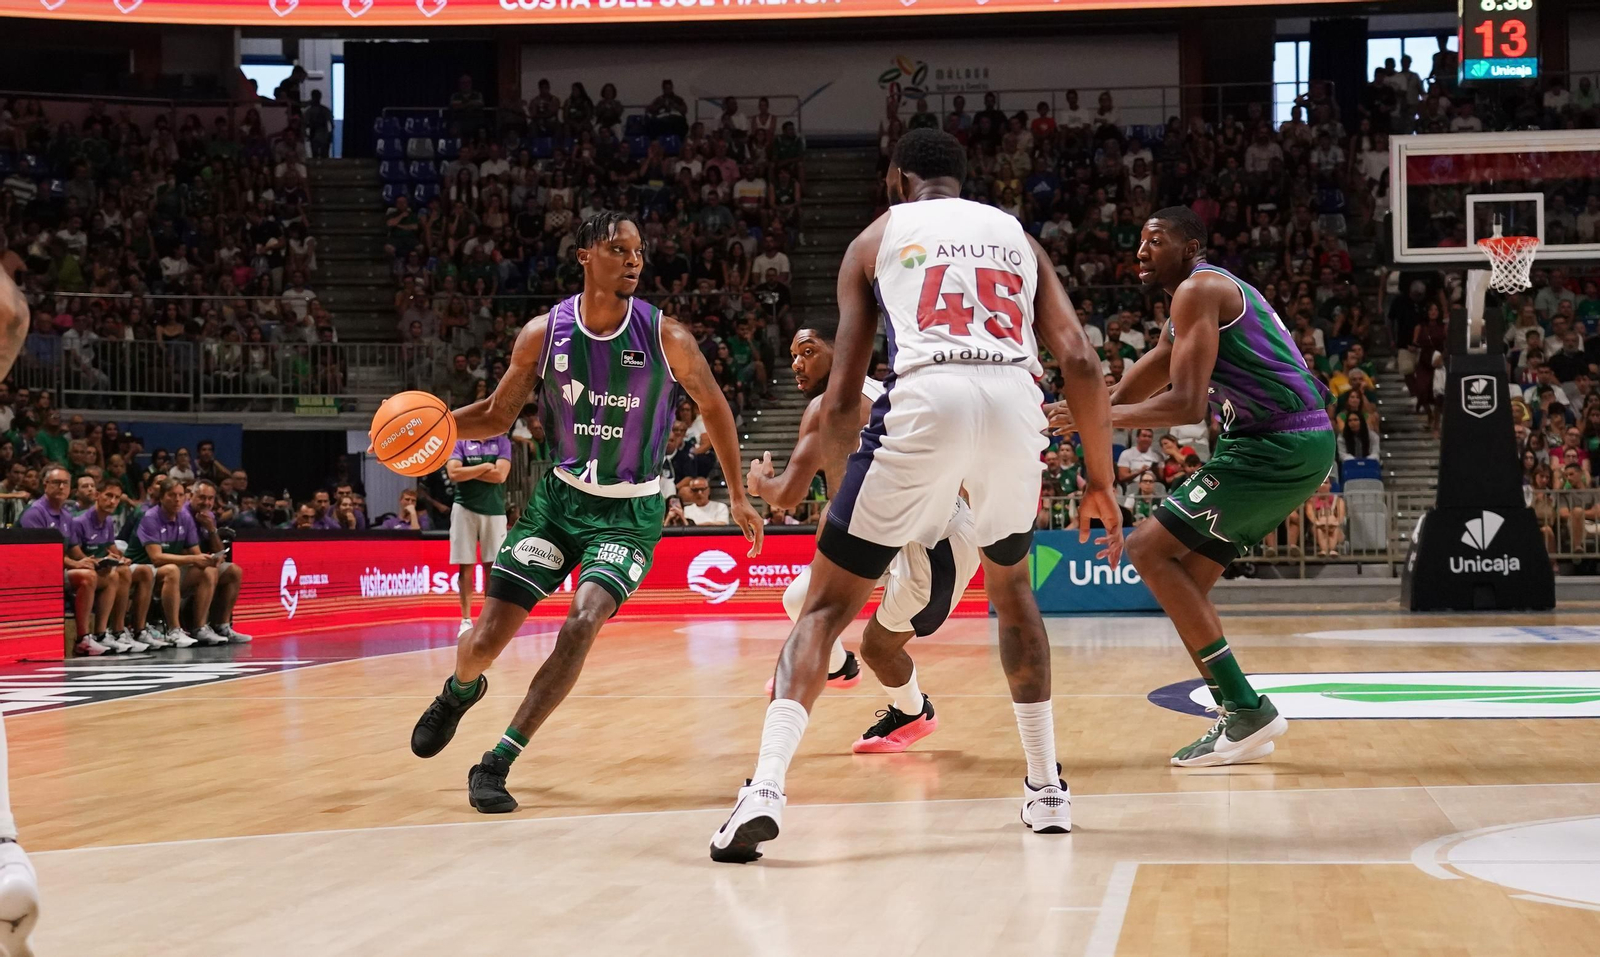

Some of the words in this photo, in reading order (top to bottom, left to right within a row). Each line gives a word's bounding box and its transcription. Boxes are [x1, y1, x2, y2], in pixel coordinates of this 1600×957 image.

[1474, 19, 1528, 57] 13
[1490, 64, 1533, 78] Unicaja
[936, 244, 1022, 266] AMUTIO
[916, 264, 1024, 346] 45
[588, 390, 641, 412] Unicaja
[391, 435, 443, 470] Wilson
[748, 565, 790, 576] COSTA
[1069, 560, 1142, 586] Unic
[1449, 554, 1520, 576] Unicaja
